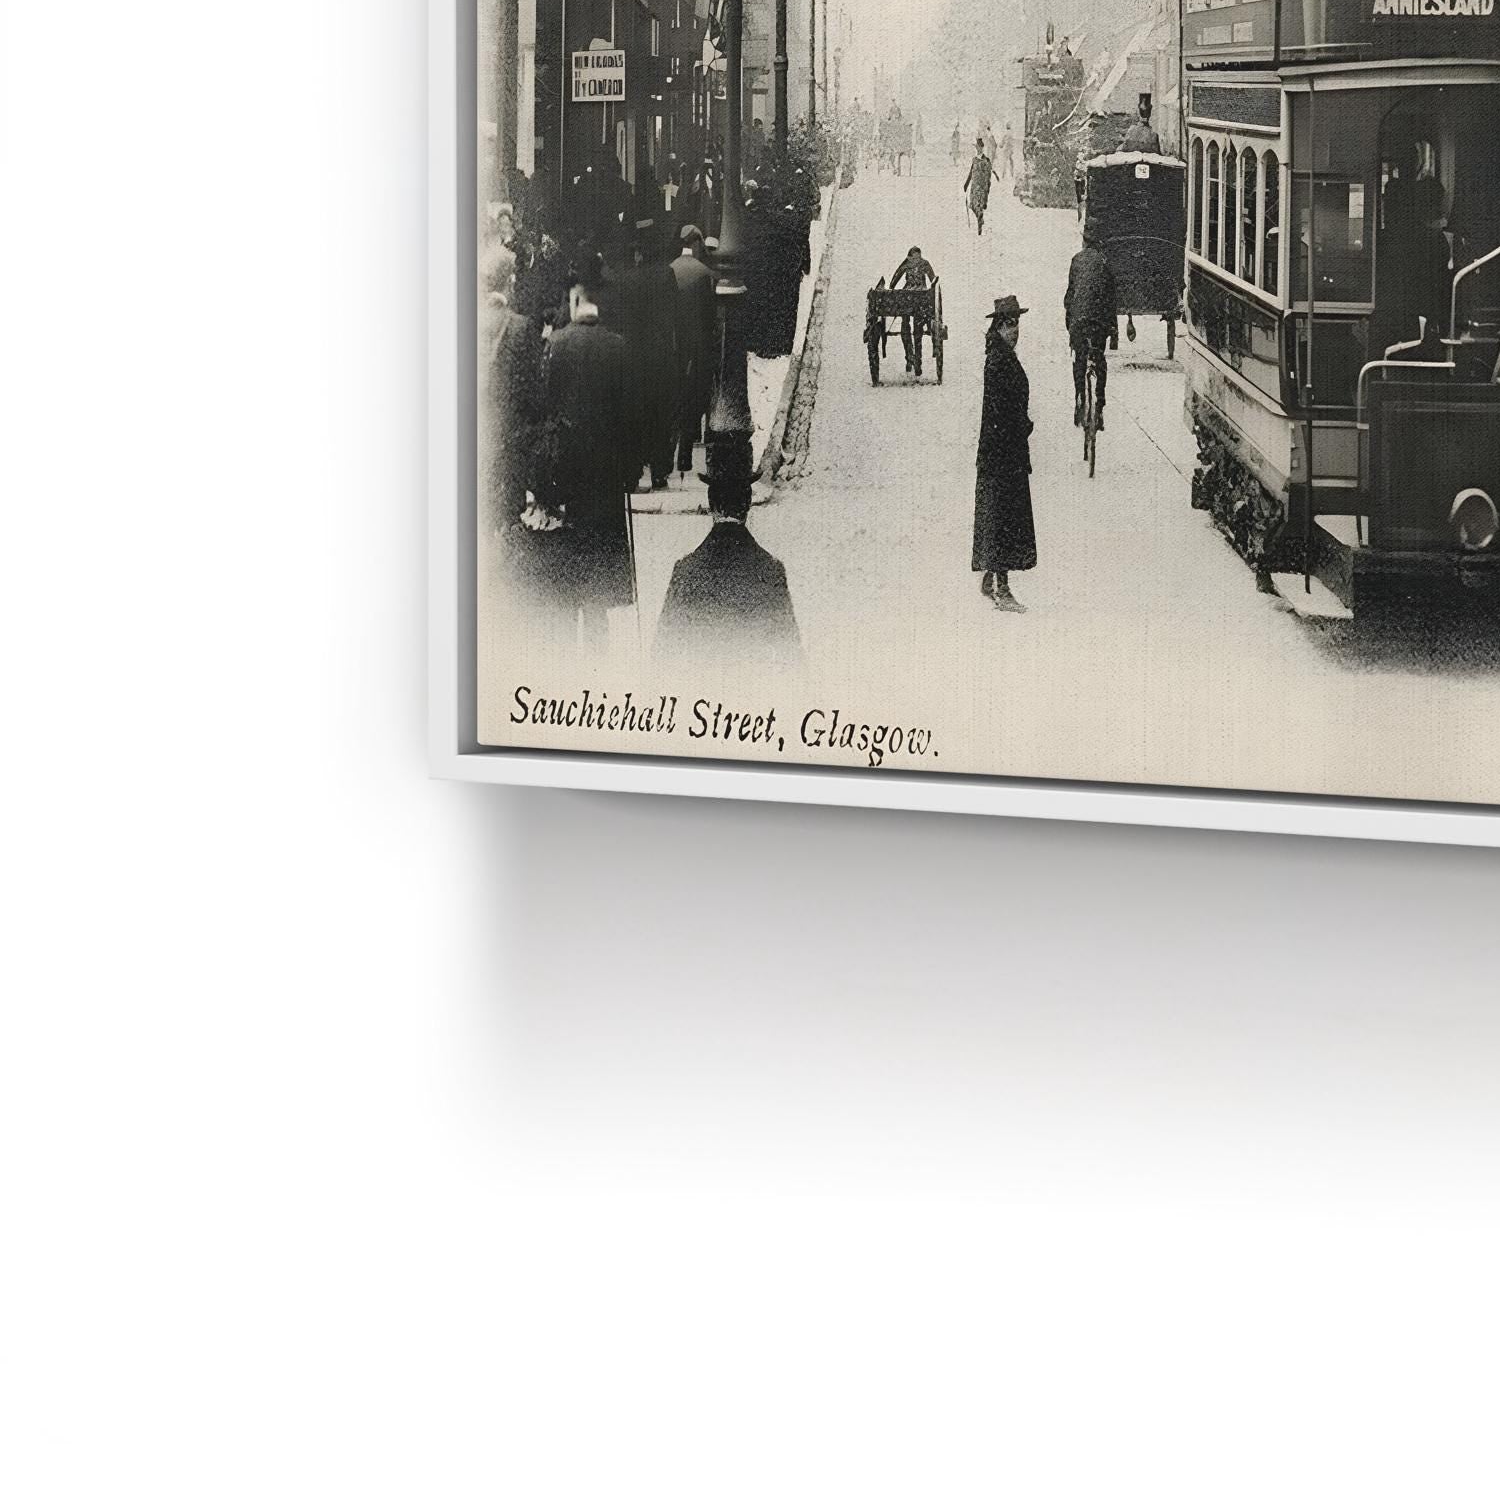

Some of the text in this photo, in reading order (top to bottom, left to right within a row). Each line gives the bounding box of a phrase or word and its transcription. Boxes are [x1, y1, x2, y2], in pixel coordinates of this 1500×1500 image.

[511, 686, 939, 767] Sauchiehall Street, Glasgow.
